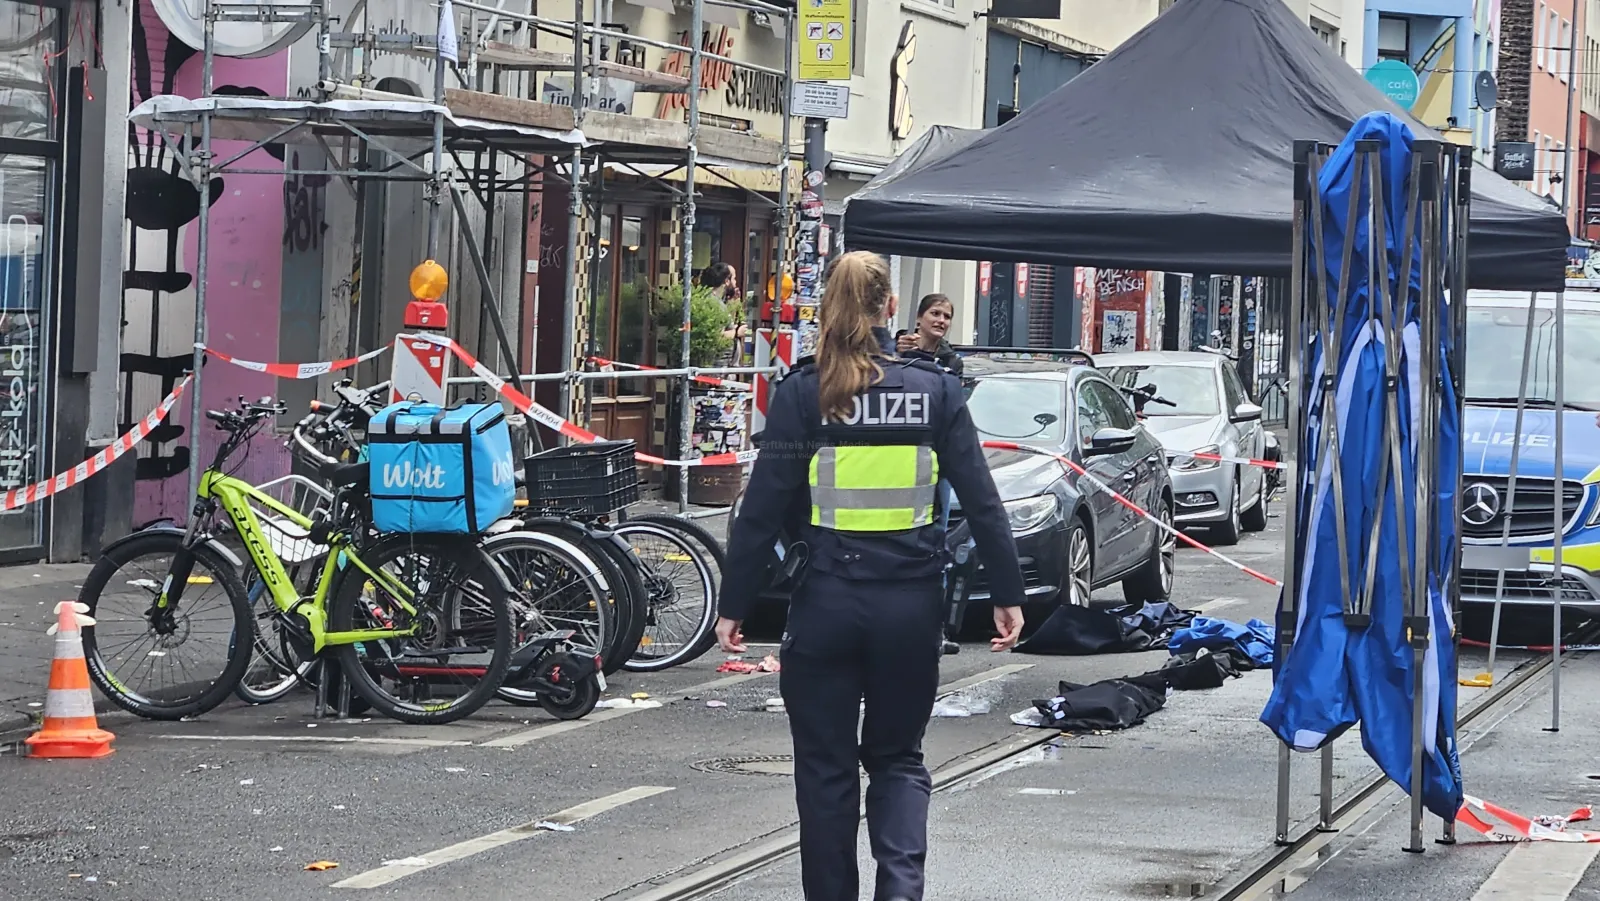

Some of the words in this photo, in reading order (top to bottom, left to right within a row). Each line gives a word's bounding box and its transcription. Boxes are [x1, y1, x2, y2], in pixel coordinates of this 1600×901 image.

[726, 66, 785, 115] SCHAWAR
[1388, 80, 1412, 89] café
[550, 92, 617, 109] tinhar
[1098, 277, 1145, 296] BENSCH
[0, 345, 25, 490] fritz-kola
[821, 392, 931, 427] OLIZEI
[1463, 431, 1557, 449] LIZE
[383, 460, 446, 489] Wolt
